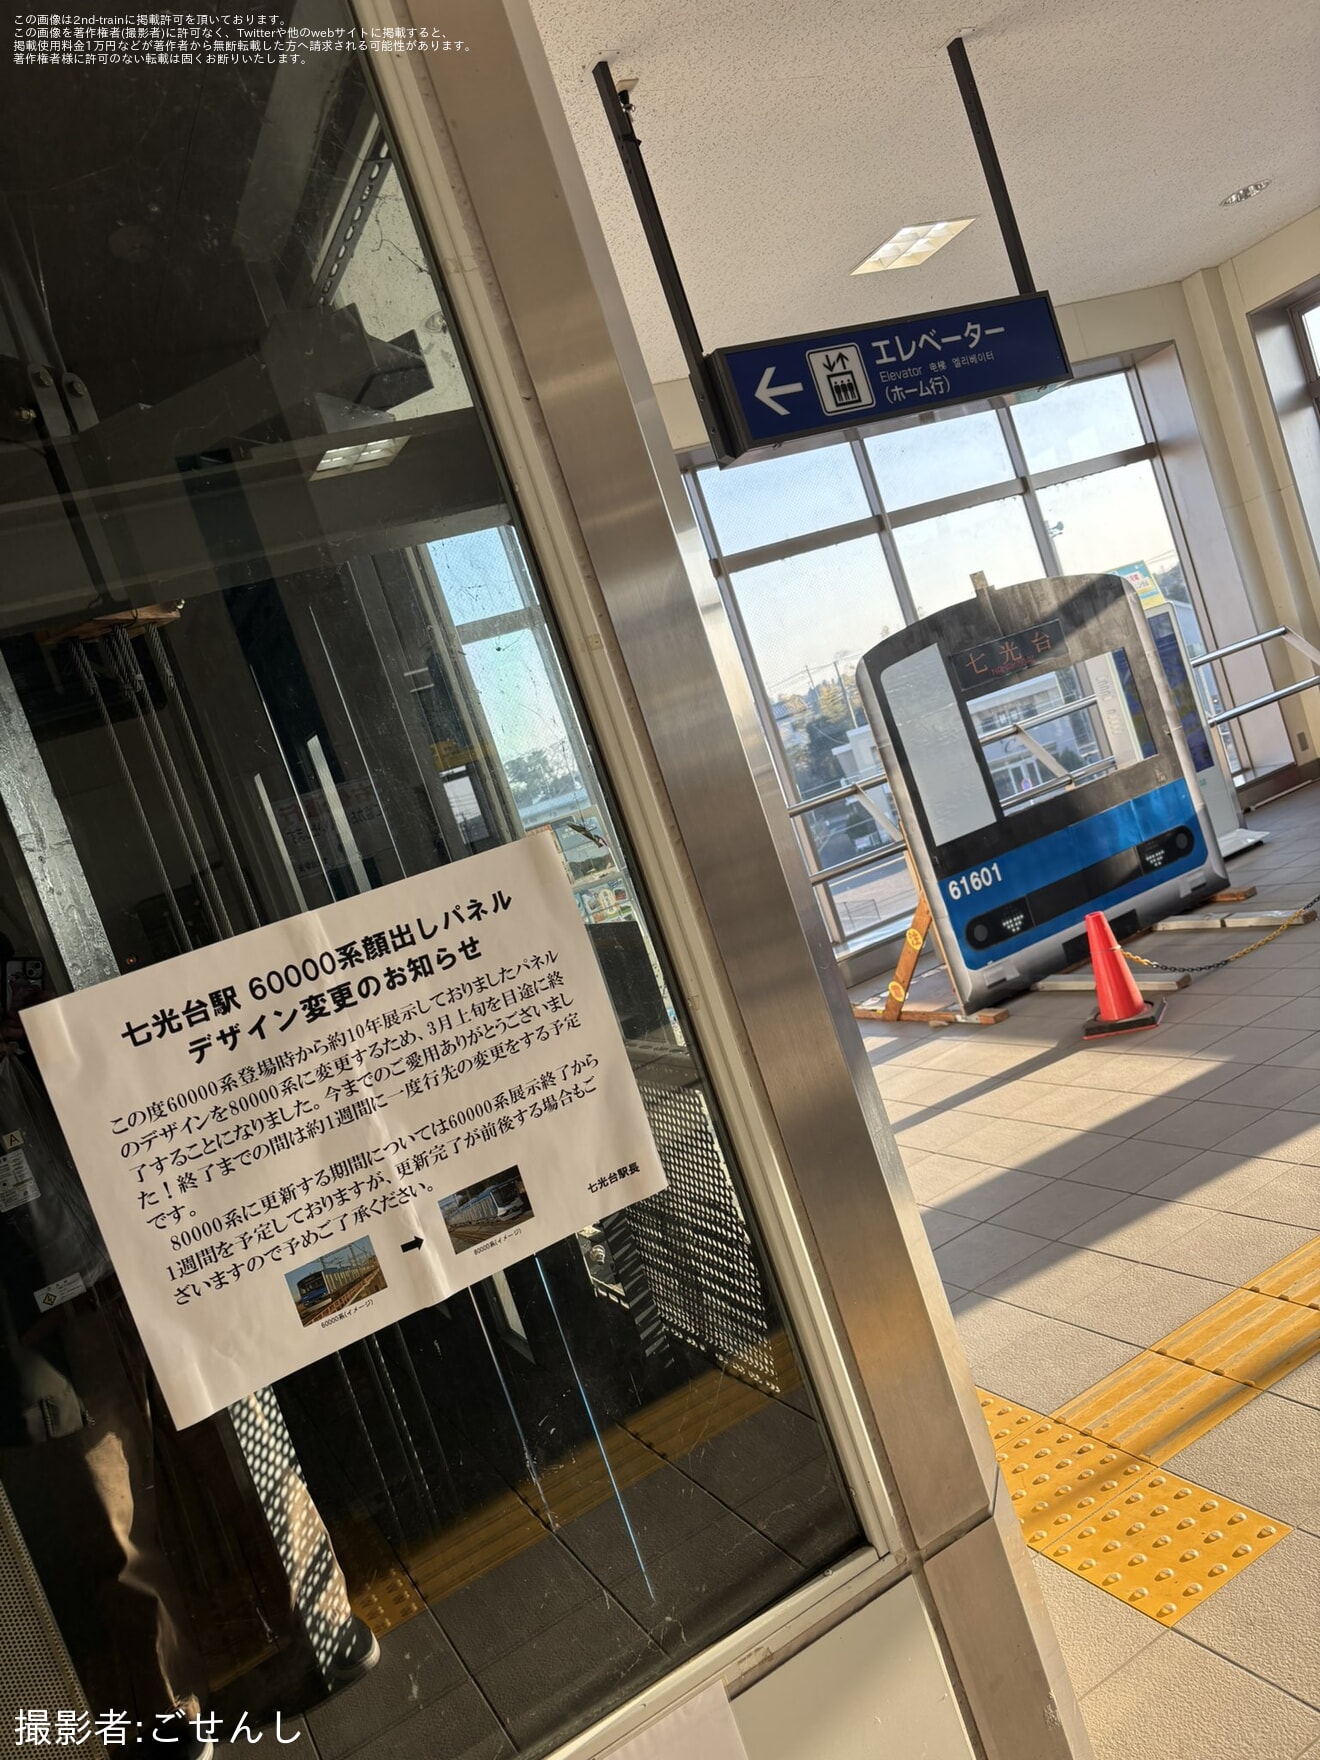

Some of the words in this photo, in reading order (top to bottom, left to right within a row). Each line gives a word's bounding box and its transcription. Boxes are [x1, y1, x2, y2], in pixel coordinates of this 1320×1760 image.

[871, 322, 1005, 366] エレベーター
[879, 365, 923, 383] Elevator
[885, 375, 951, 404] (ホーム行)
[965, 631, 1051, 674] 七光台
[948, 862, 1003, 901] 61601
[120, 984, 241, 1049] 七光台駅
[248, 889, 513, 1002] 60000系顔出しパネル
[188, 936, 483, 1065] デザイン変更のお知らせ
[109, 949, 560, 1135] この度60000系登場時から約10年展示しておりましたパネル
[120, 971, 565, 1159] のデザインを80000系に変更するため、3月上旬を目途に終
[128, 995, 574, 1184] 了することになりました。今までのご愛用ありがとうございまし
[165, 1078, 596, 1282] 1週間を予定しておりますが、更新完了が前後する場合もご
[170, 1053, 600, 1252] 80000系に更新する期間については60000系展示終了から
[587, 1161, 641, 1194] 七光台駅長
[147, 1203, 197, 1231] です。
[172, 1183, 434, 1306] ざいますので予めご了承ください。
